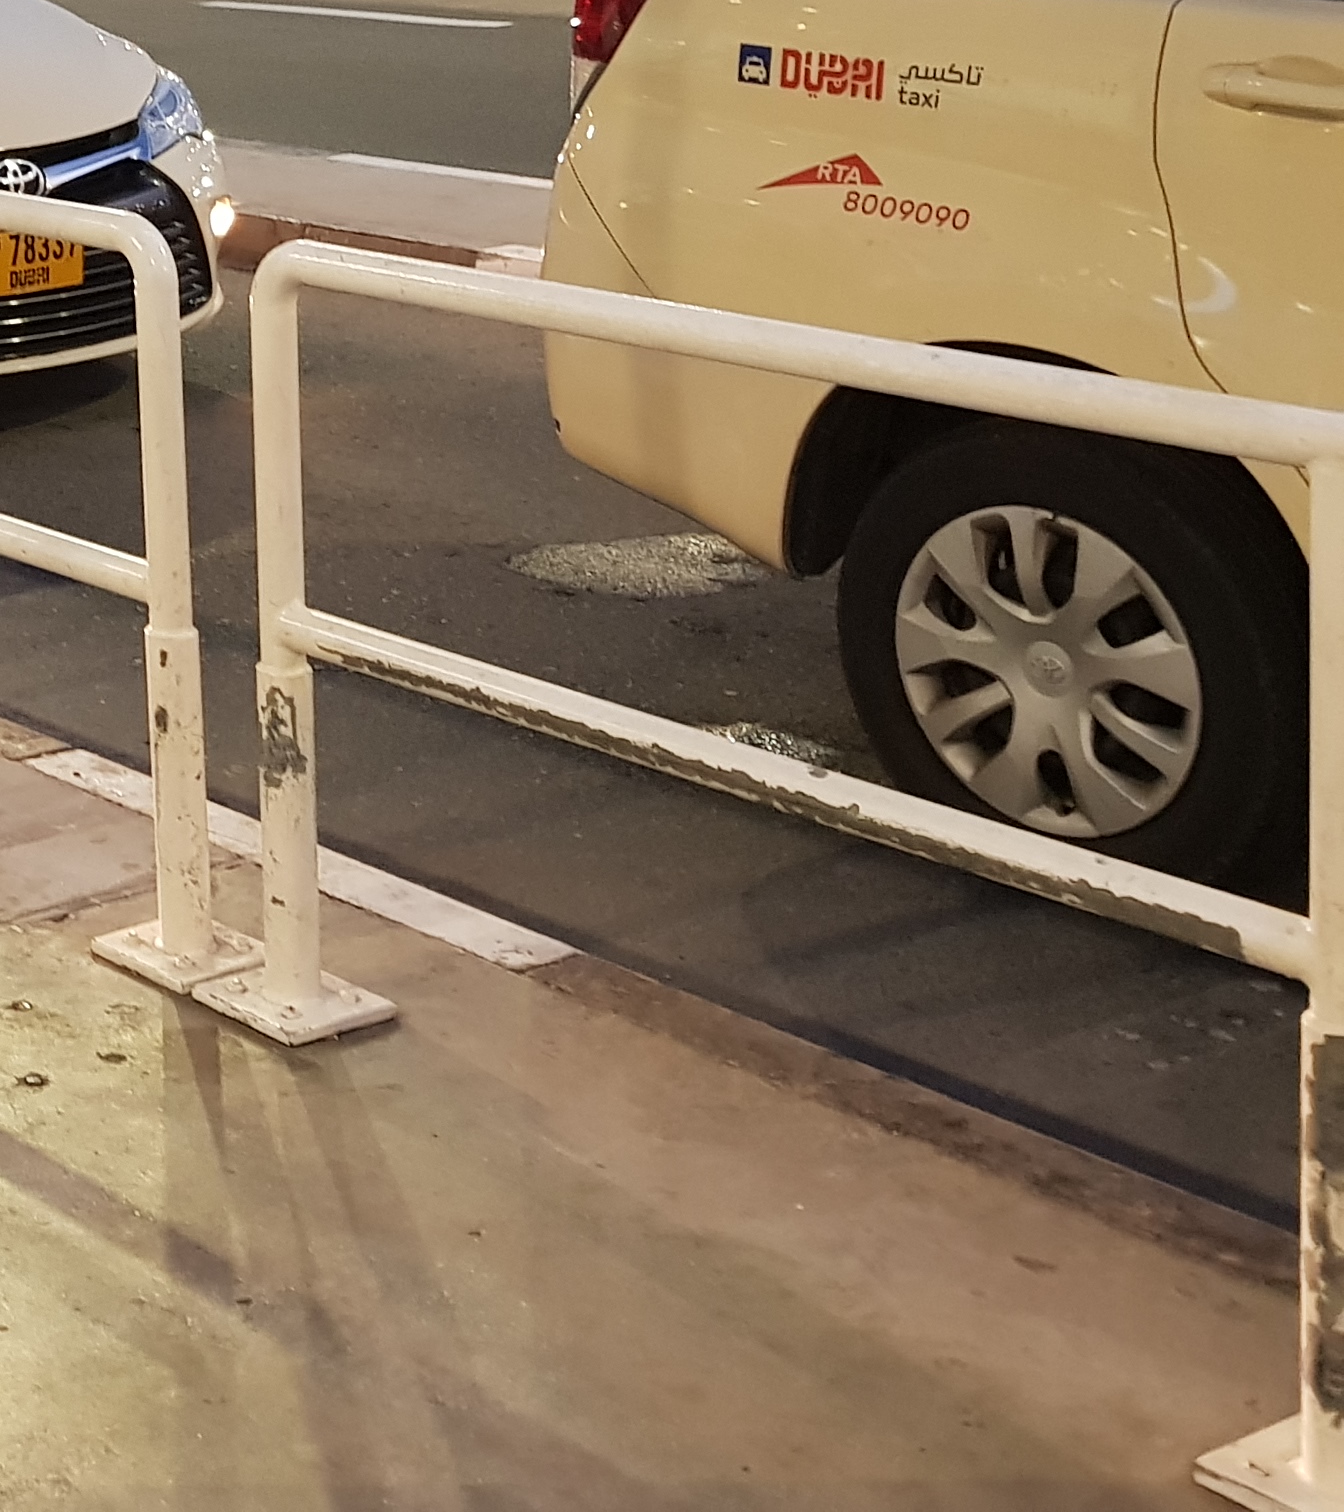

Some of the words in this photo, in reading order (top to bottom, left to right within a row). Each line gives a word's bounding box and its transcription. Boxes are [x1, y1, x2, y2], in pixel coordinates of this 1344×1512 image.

[780, 47, 886, 102] DUBAI
[898, 62, 985, 87] تاكسي
[898, 85, 941, 110] taxi
[816, 162, 863, 186] RTA
[843, 190, 971, 231] 8009090
[10, 267, 50, 288] DUBAI
